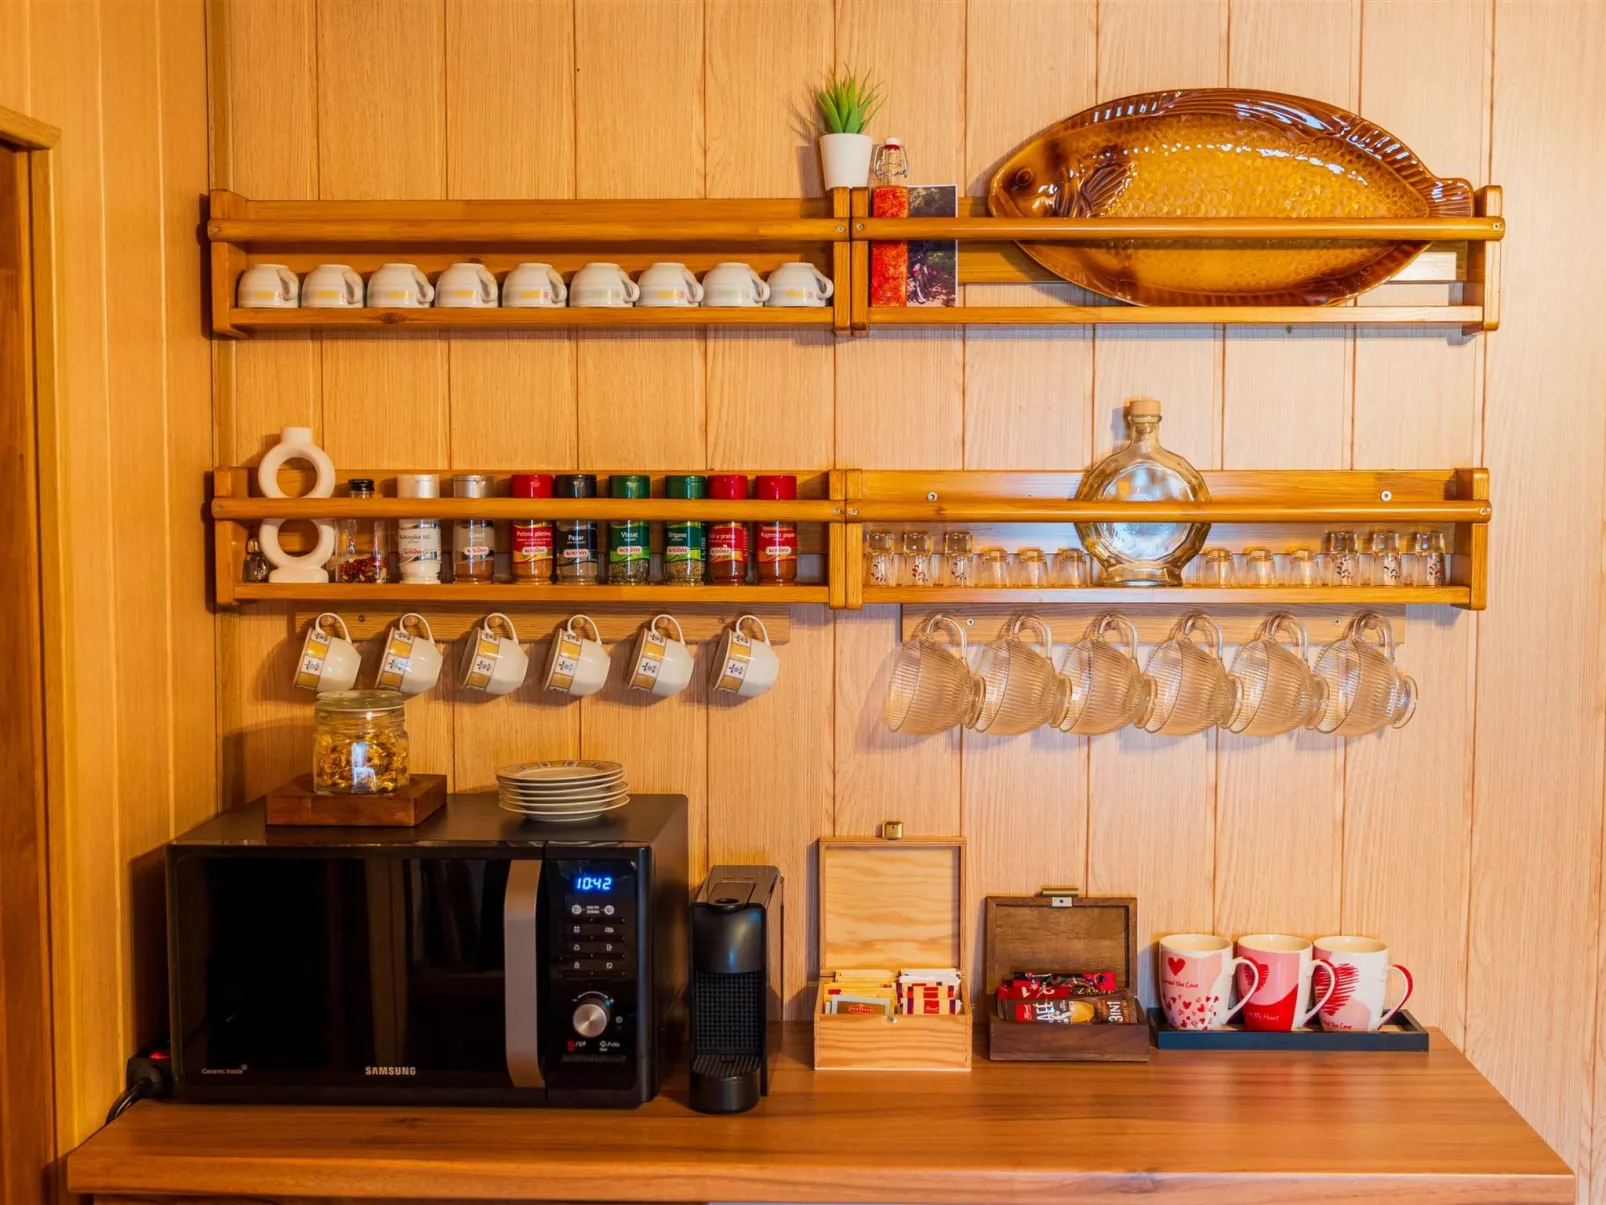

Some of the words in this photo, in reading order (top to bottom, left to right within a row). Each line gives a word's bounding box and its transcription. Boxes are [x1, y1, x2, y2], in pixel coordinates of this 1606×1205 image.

[576, 877, 612, 890] 10:42
[1186, 981, 1199, 989] Love
[365, 1066, 417, 1076] SAMSUNG
